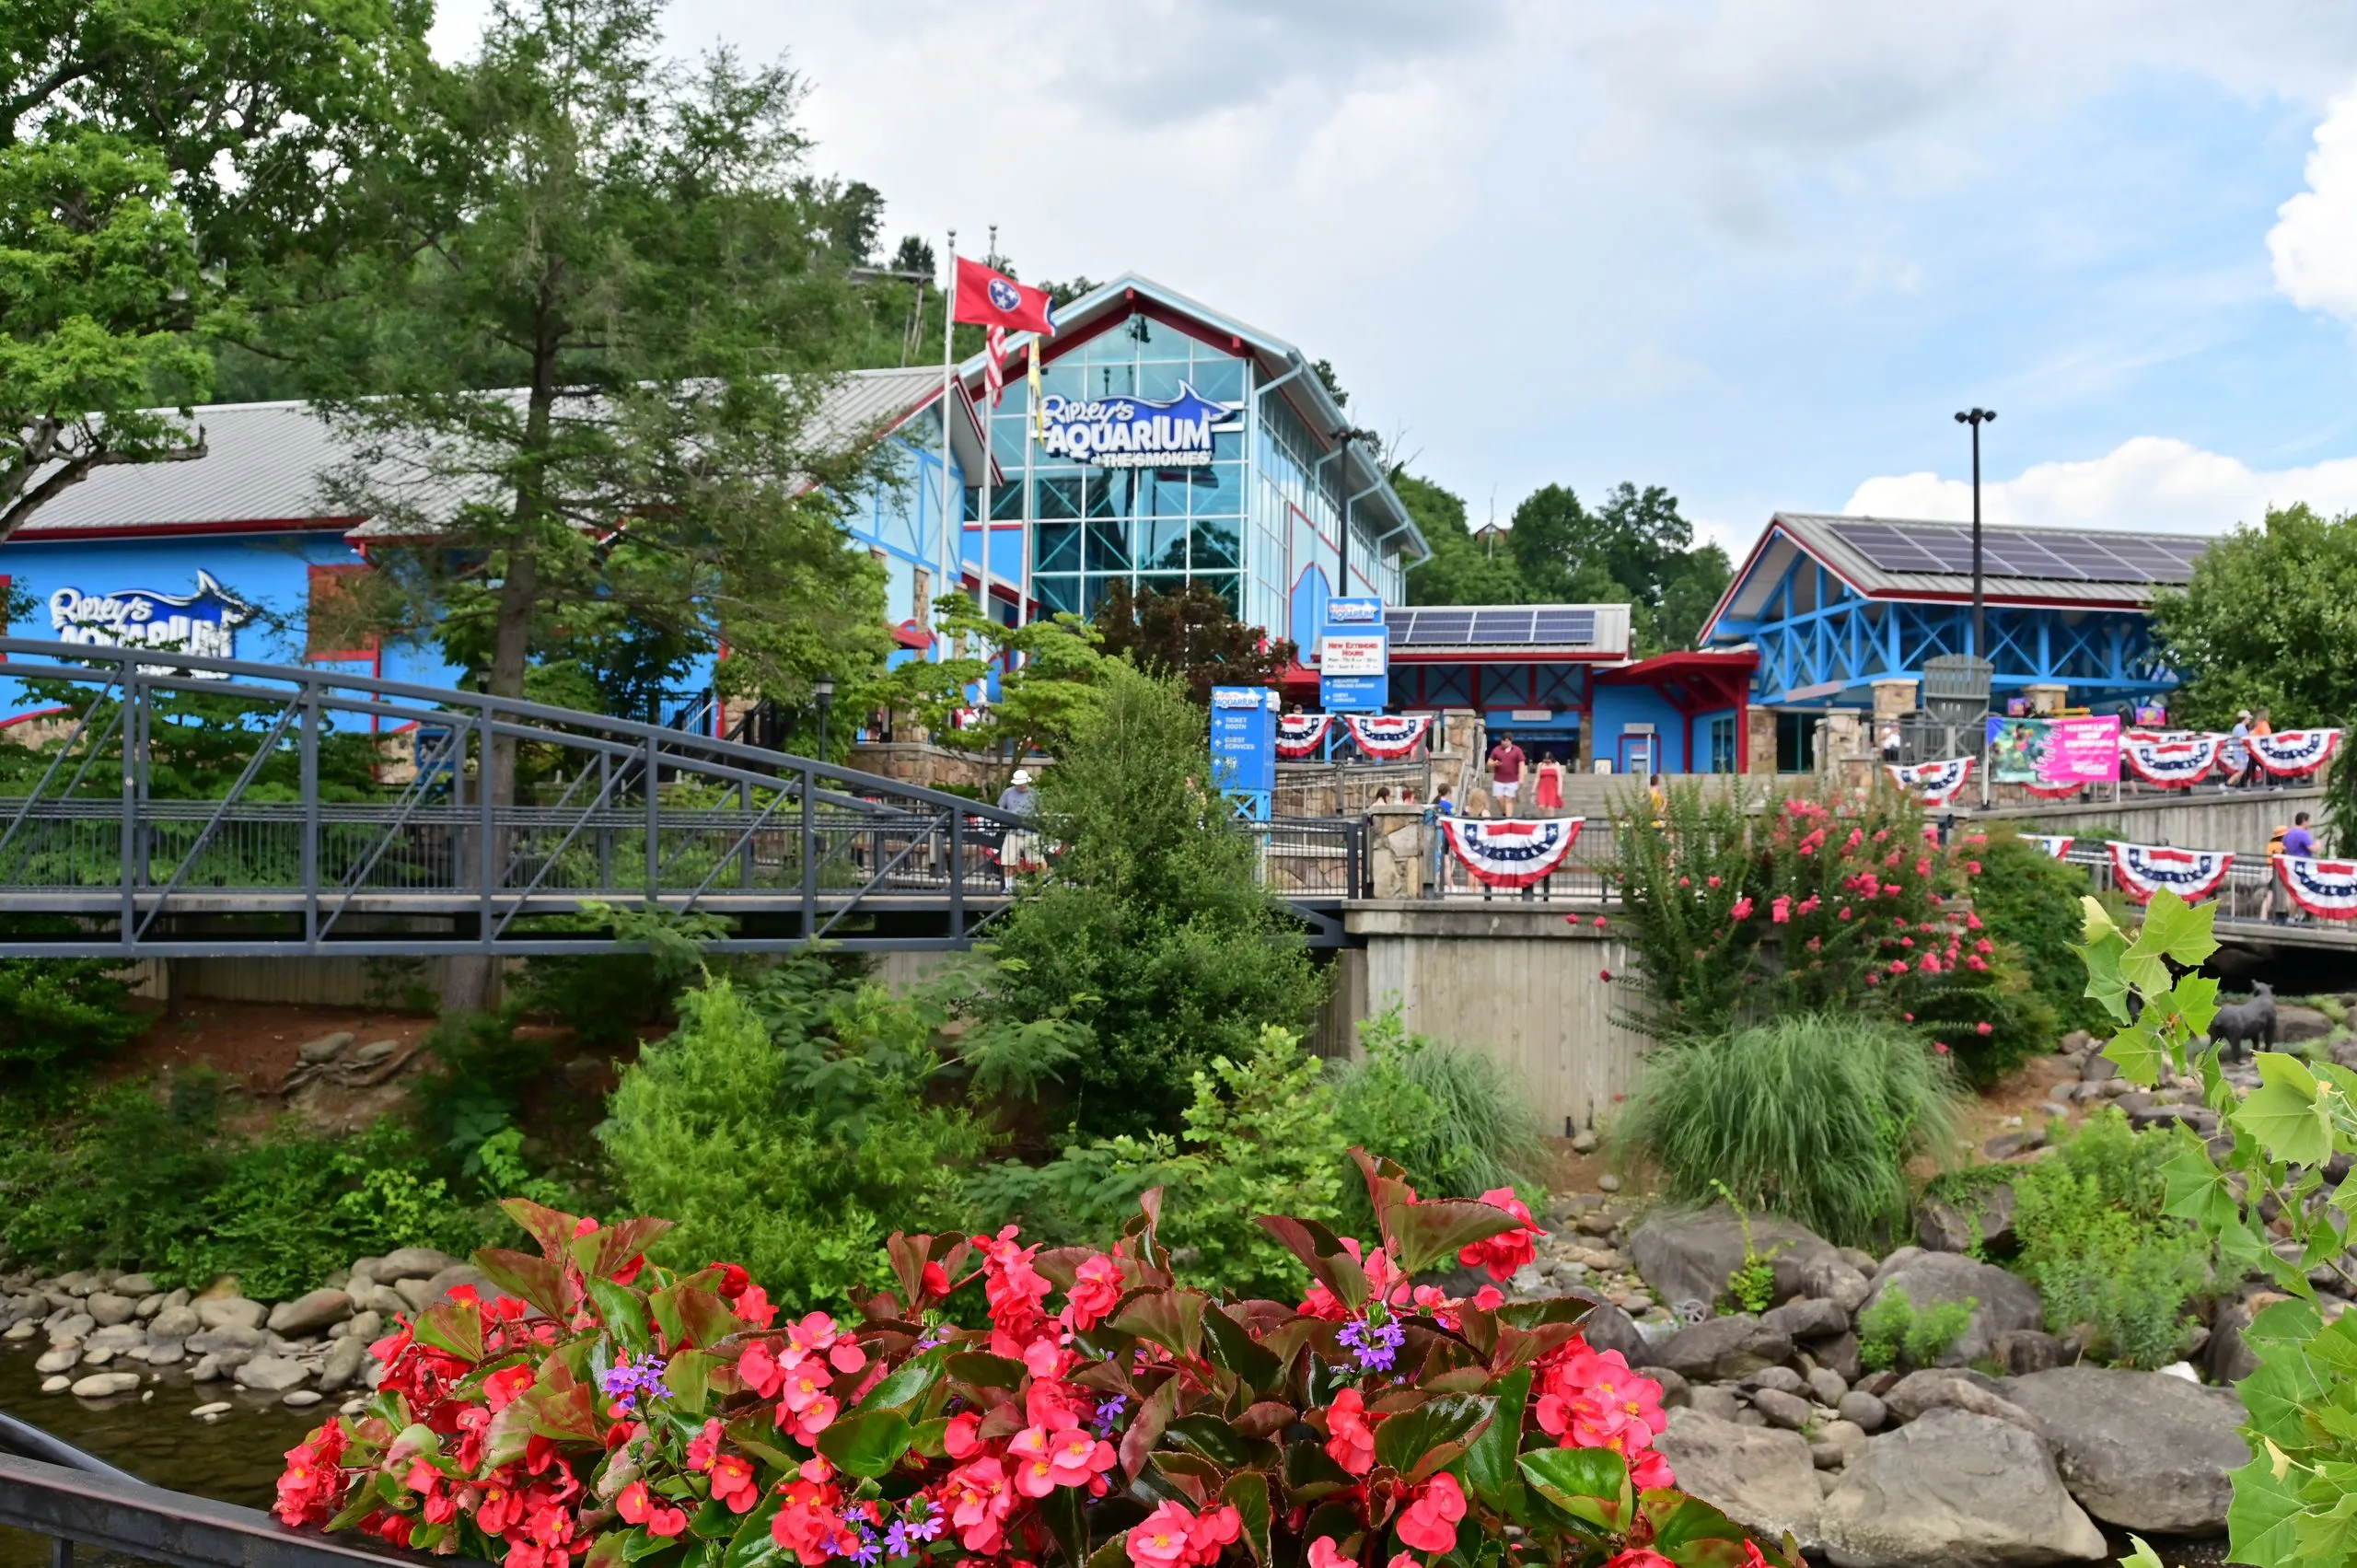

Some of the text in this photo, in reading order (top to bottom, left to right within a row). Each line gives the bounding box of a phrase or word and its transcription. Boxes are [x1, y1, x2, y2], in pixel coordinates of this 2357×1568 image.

[1046, 415, 1212, 459] AQUARIUM
[1103, 453, 1132, 467] THE
[1132, 451, 1212, 467] SMOKIES
